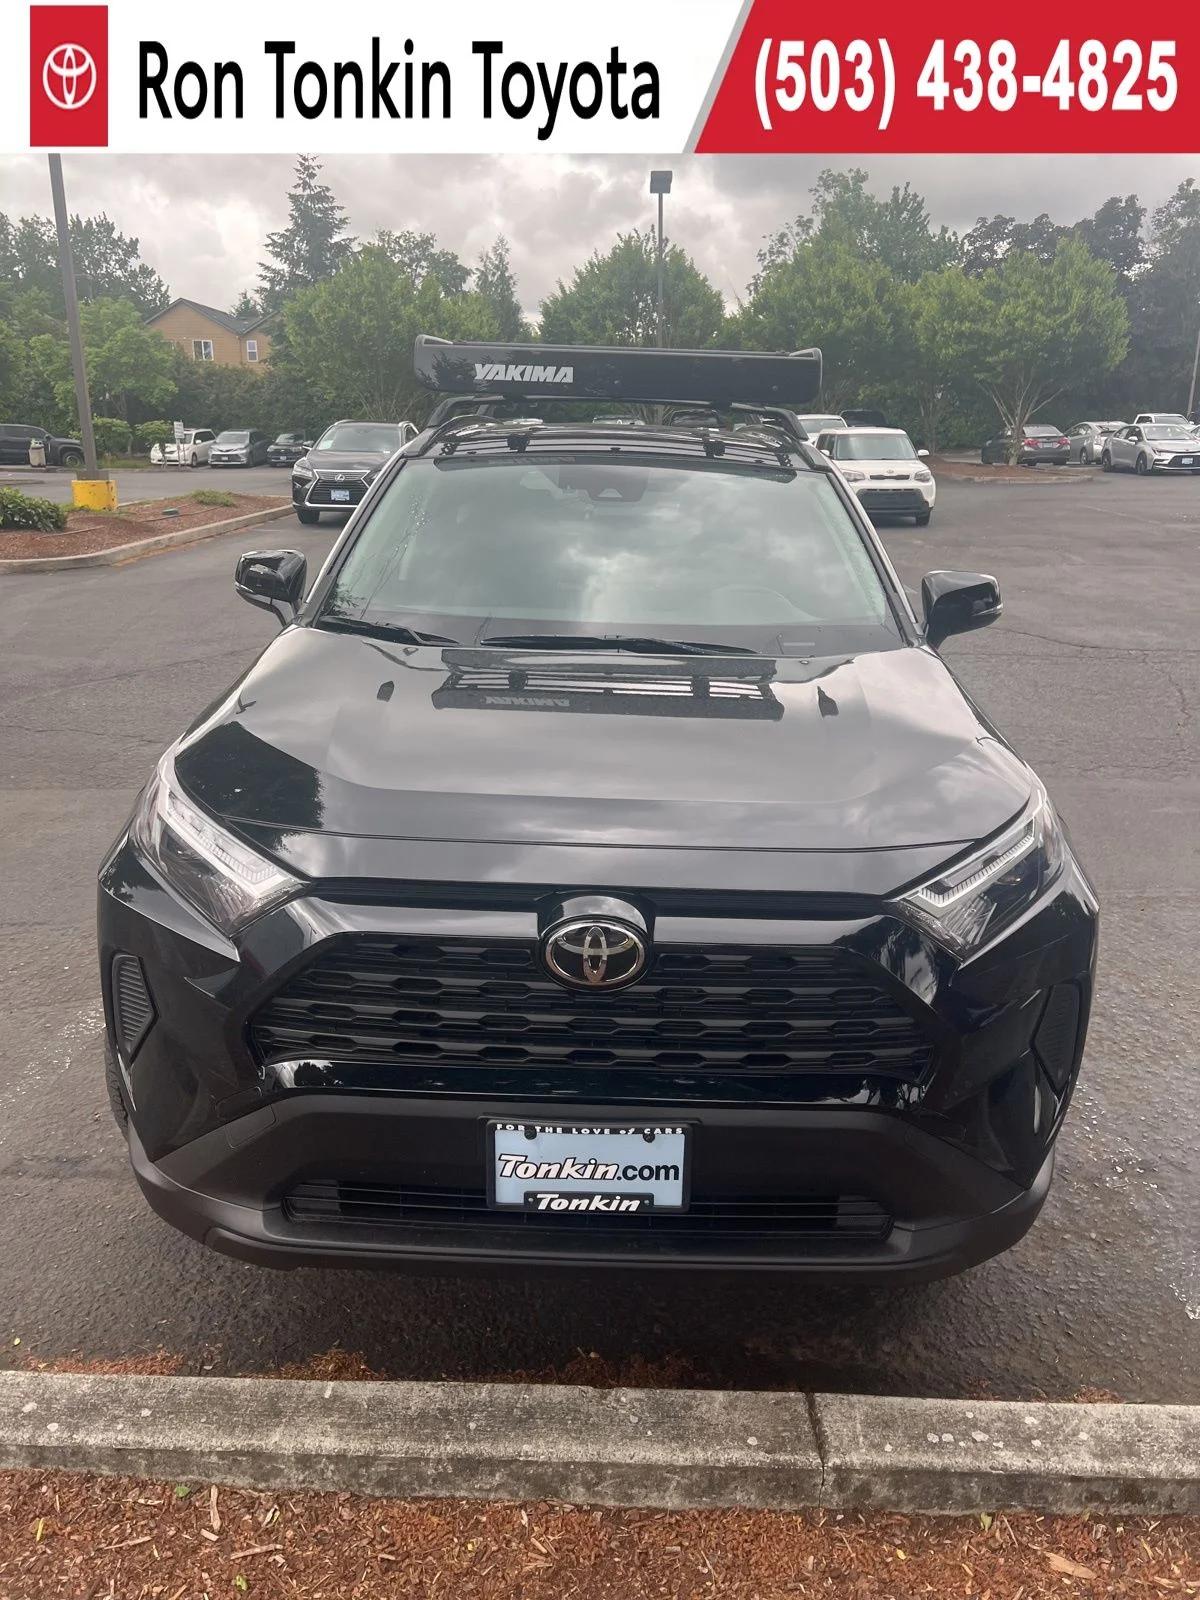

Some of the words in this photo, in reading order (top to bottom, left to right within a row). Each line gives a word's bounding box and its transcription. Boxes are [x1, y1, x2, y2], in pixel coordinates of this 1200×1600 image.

[474, 363, 574, 383] YAKIMA
[496, 1123, 525, 1132] FOR
[535, 1126, 563, 1134] THE
[572, 1127, 611, 1135] LOVE
[643, 1127, 683, 1136] CARS
[498, 1153, 680, 1181] Tonkin.com
[536, 1193, 641, 1212] Tonkin
